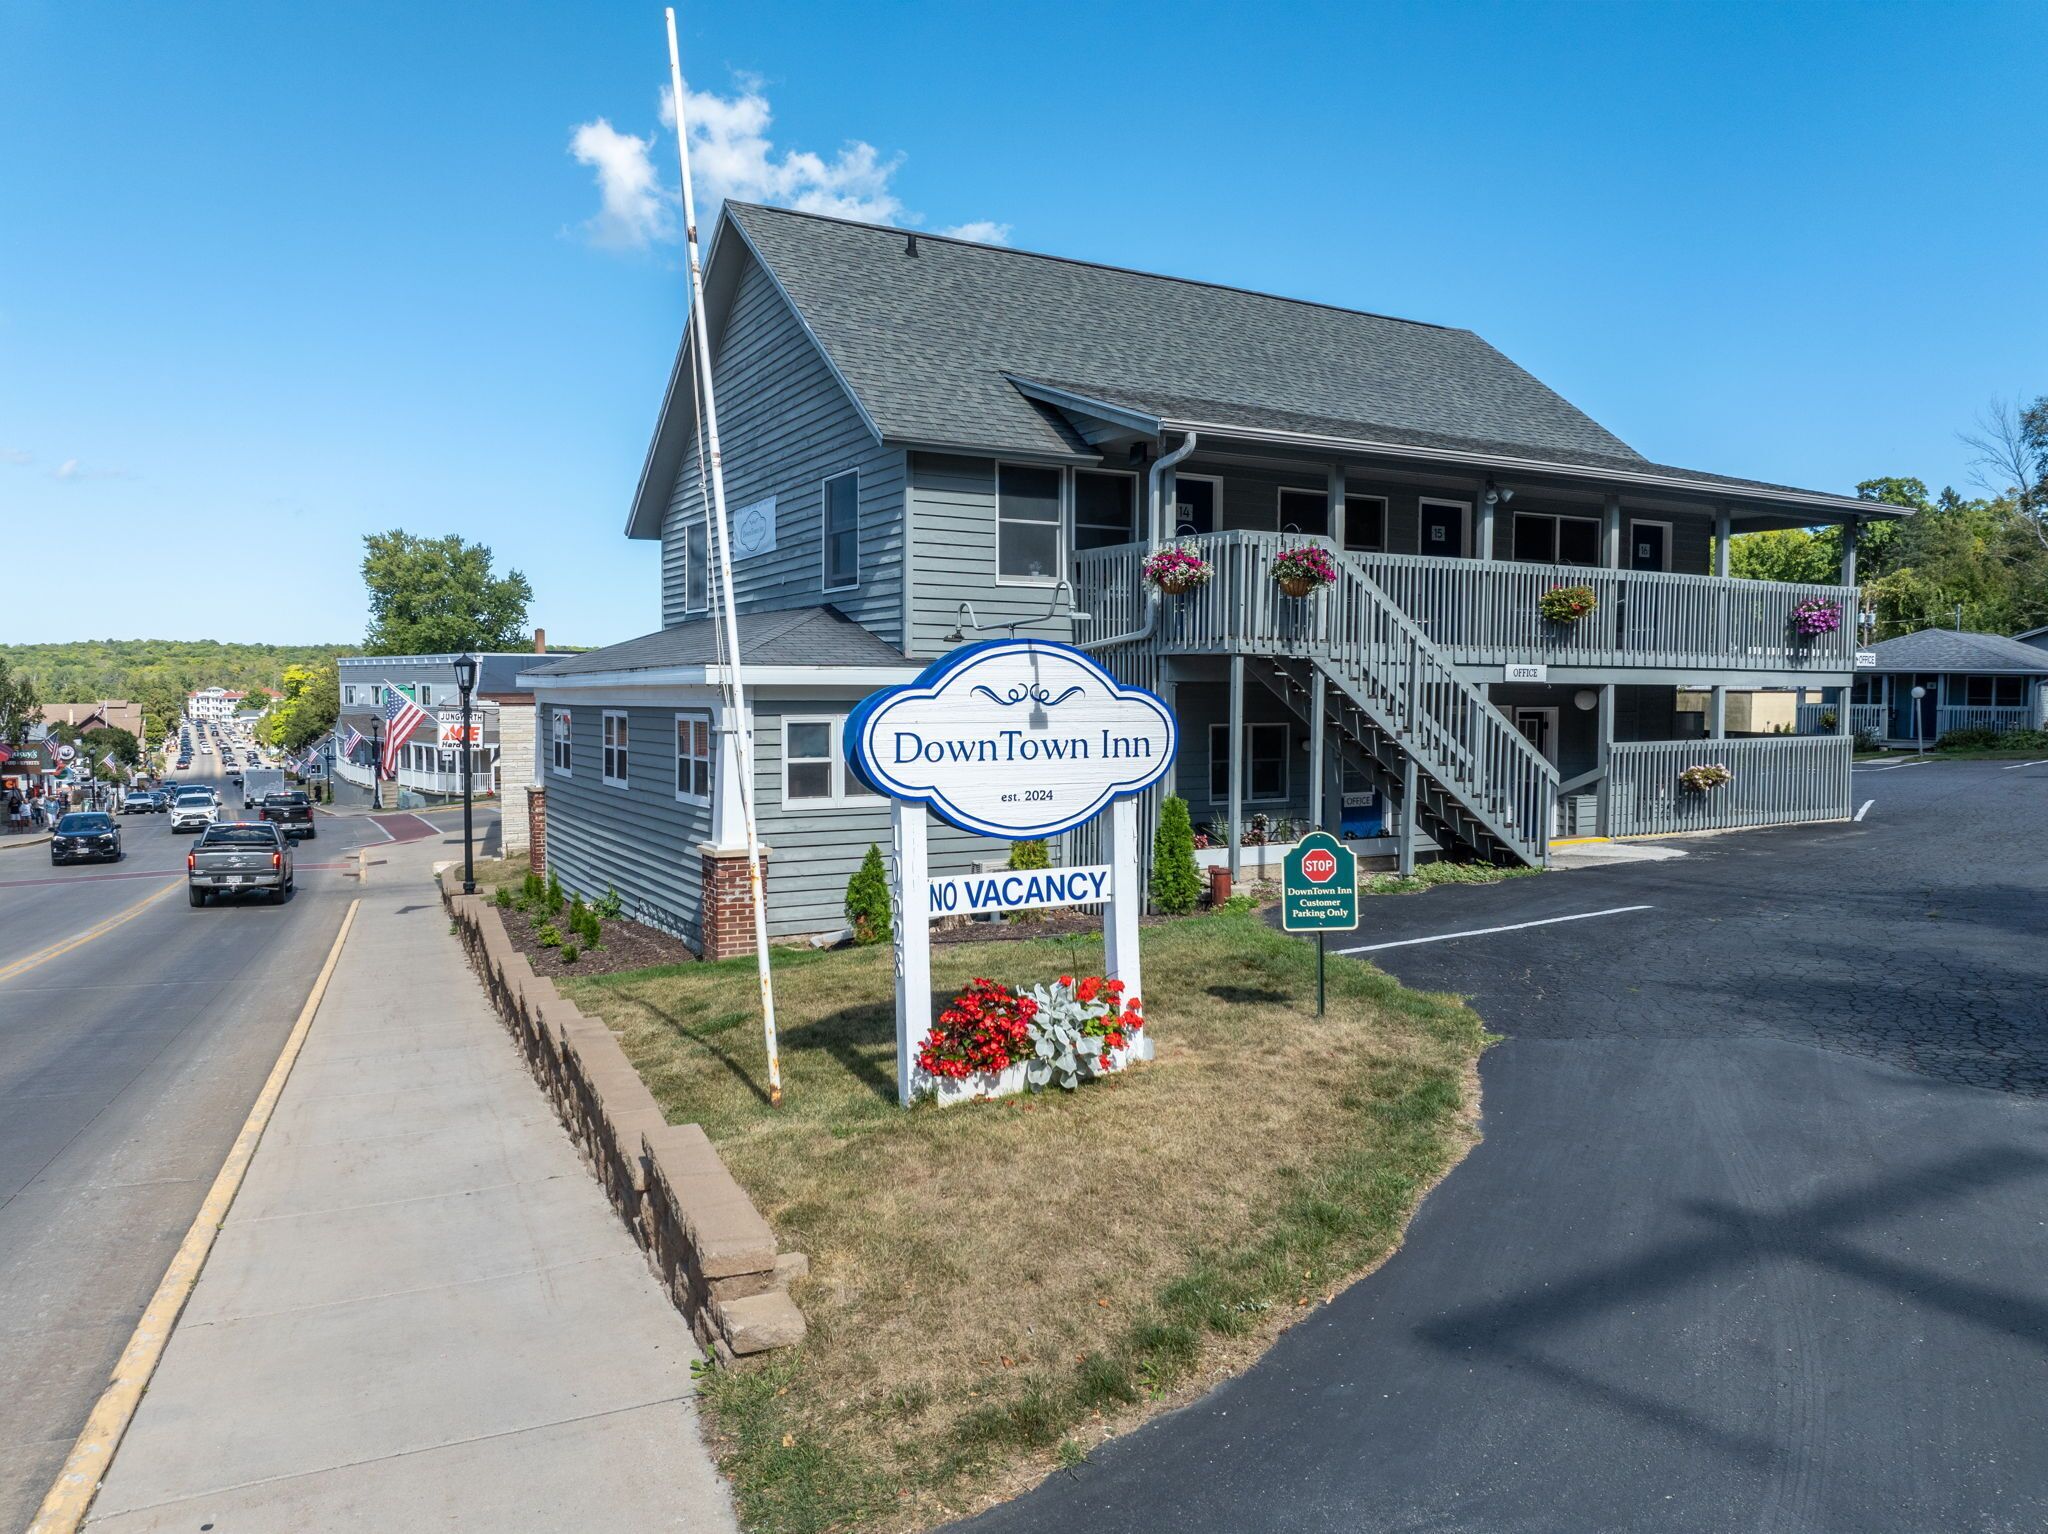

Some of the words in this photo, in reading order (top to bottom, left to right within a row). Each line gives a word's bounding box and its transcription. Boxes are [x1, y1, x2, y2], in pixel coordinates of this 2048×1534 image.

[1179, 506, 1189, 518] 14
[1434, 528, 1443, 539] 15
[1641, 546, 1649, 555] 16
[1513, 668, 1538, 677] OFFICE
[894, 731, 1090, 764] DownTown
[1101, 729, 1151, 758] Inn
[1001, 790, 1021, 802] est.
[1025, 790, 1053, 801] 2024
[1347, 797, 1371, 805] OFFICE
[1305, 860, 1332, 872] STOP
[929, 881, 957, 912] NO
[965, 871, 1107, 908] VACANCY
[1287, 887, 1335, 896] DownTown
[1337, 886, 1352, 895] Inn
[1300, 899, 1340, 907] Customer
[1292, 909, 1326, 919] Parking
[1327, 908, 1349, 919] Only
